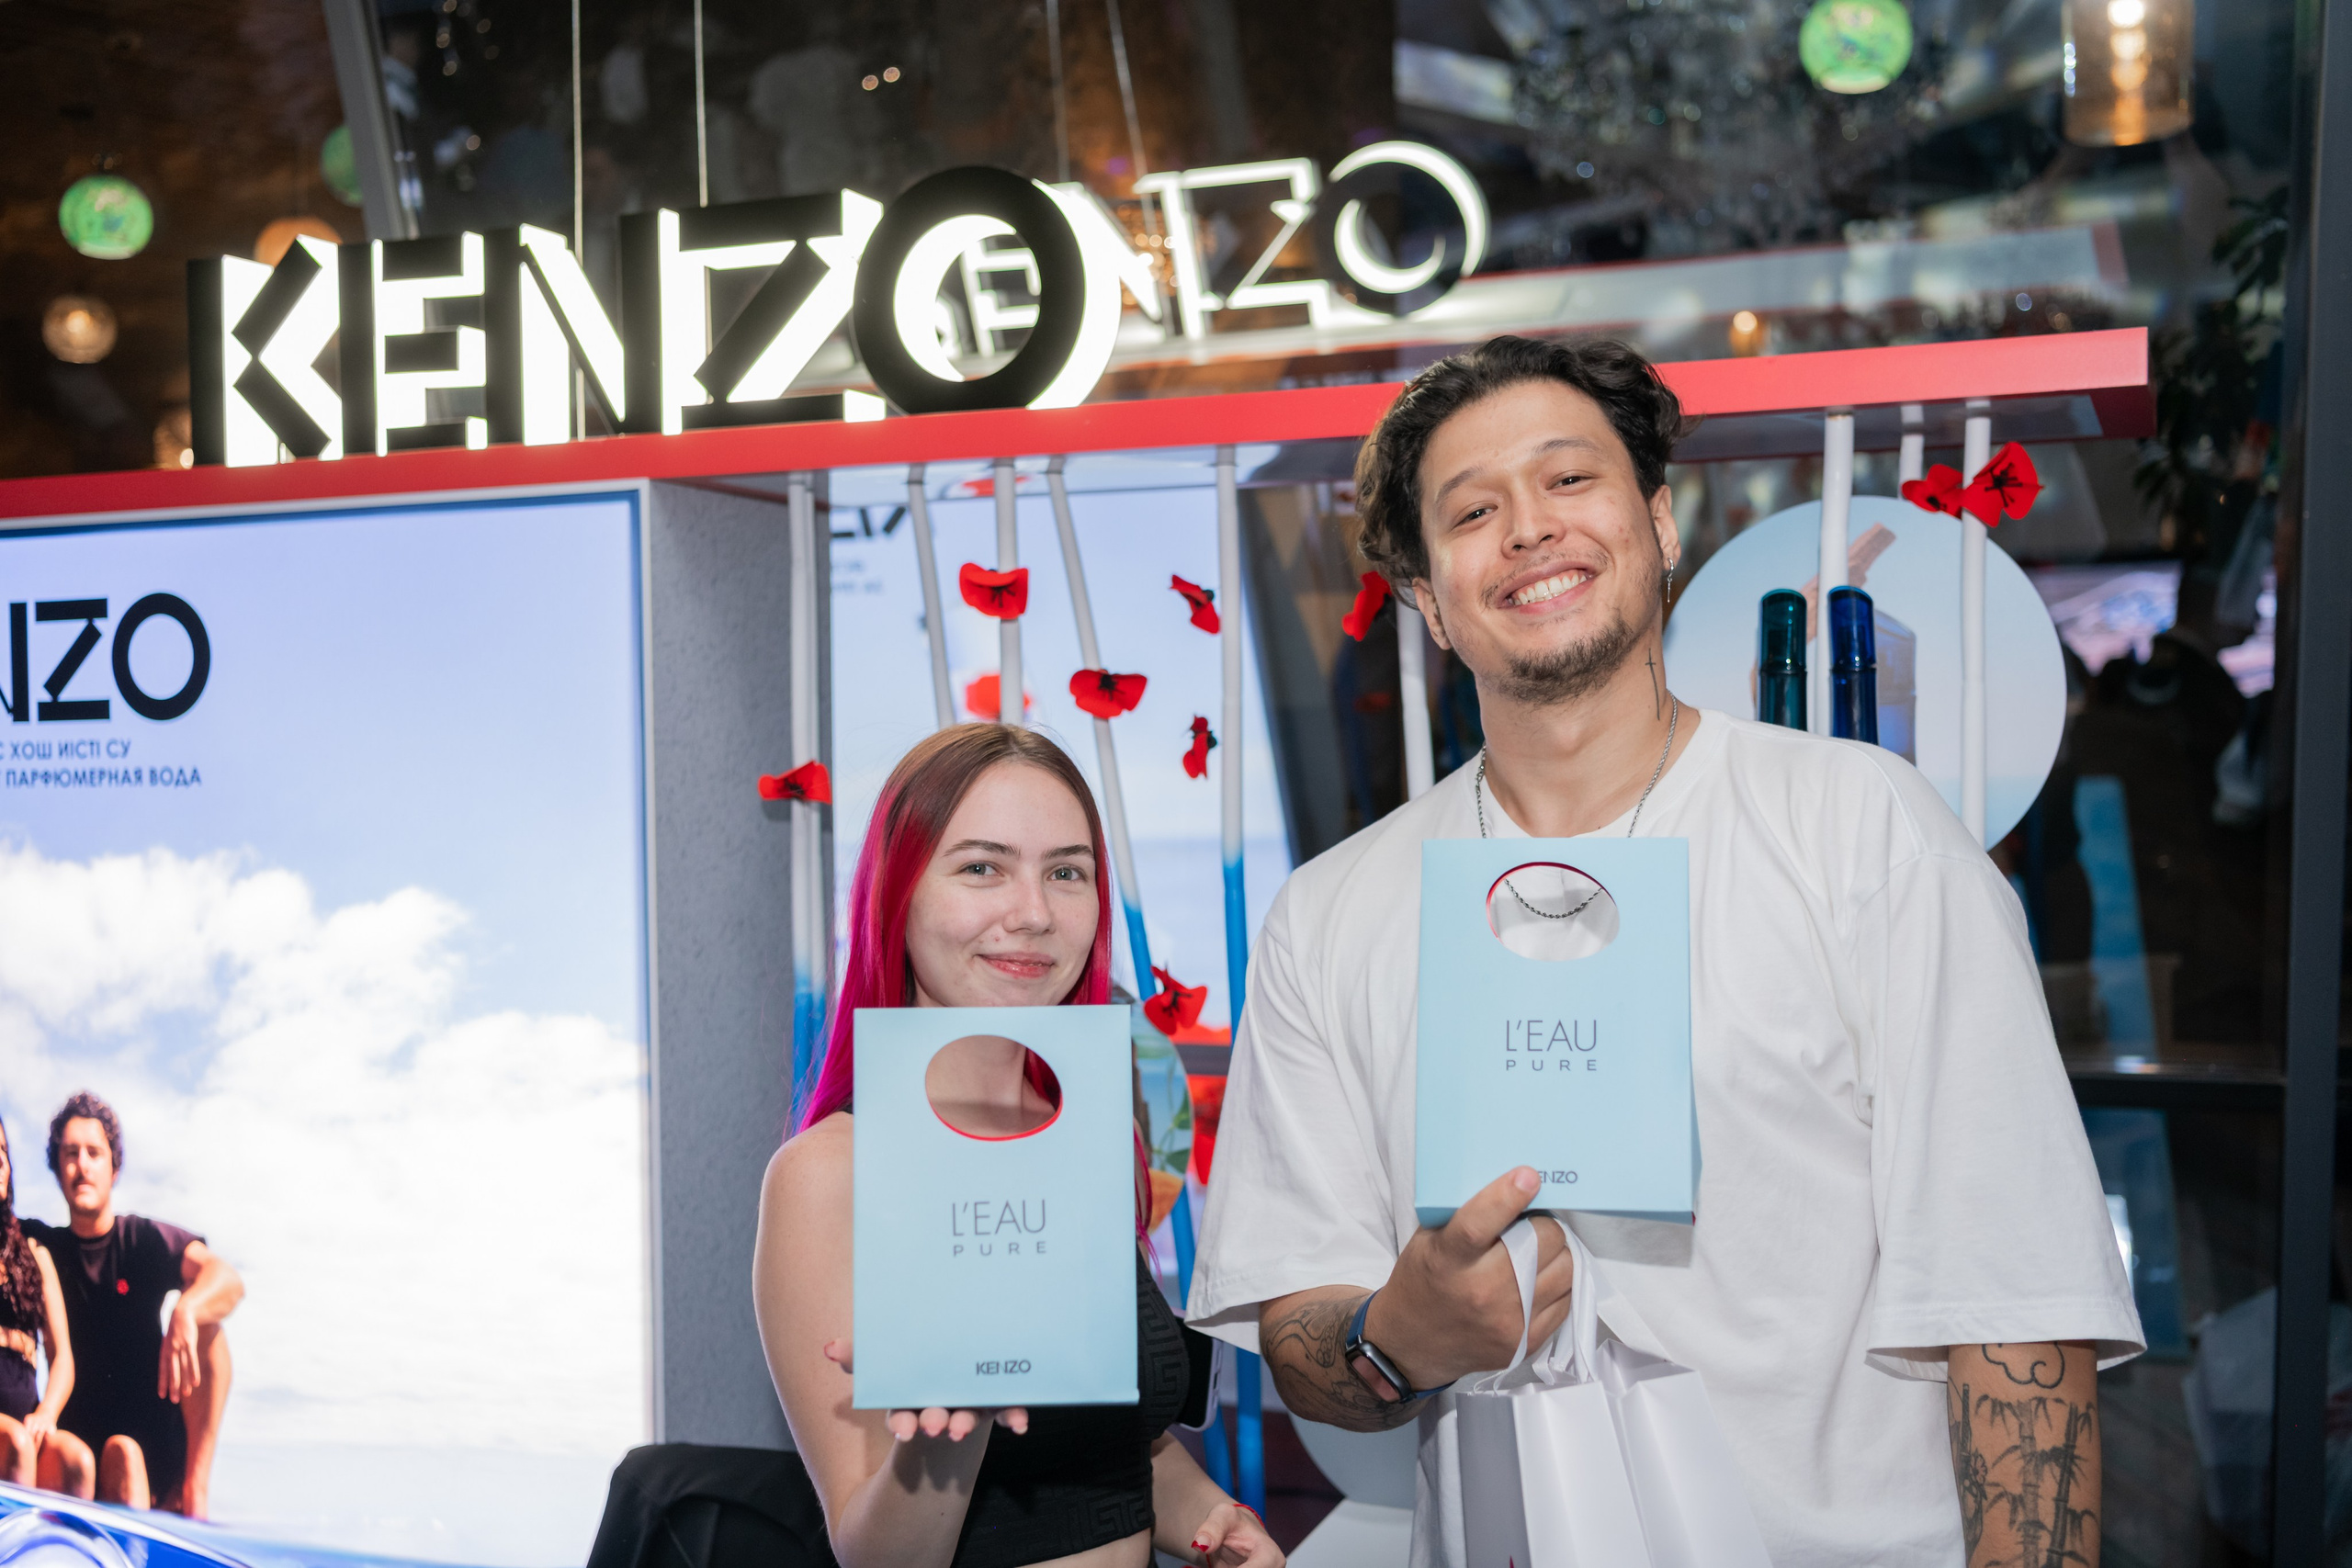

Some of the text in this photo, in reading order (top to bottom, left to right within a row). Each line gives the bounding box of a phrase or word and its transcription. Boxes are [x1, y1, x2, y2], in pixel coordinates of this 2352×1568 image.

[187, 164, 1115, 469] KENZO
[10, 739, 52, 761] ХОШ
[106, 738, 131, 760] СУ
[6, 765, 202, 789] ПАРФЮМЕРНАЯ ВОДА
[1506, 1019, 1597, 1052] L'EAU
[1506, 1059, 1598, 1072] PURE
[952, 1198, 1046, 1236] L'EAU
[953, 1240, 1047, 1257] PURE
[976, 1359, 1032, 1376] KENZO
